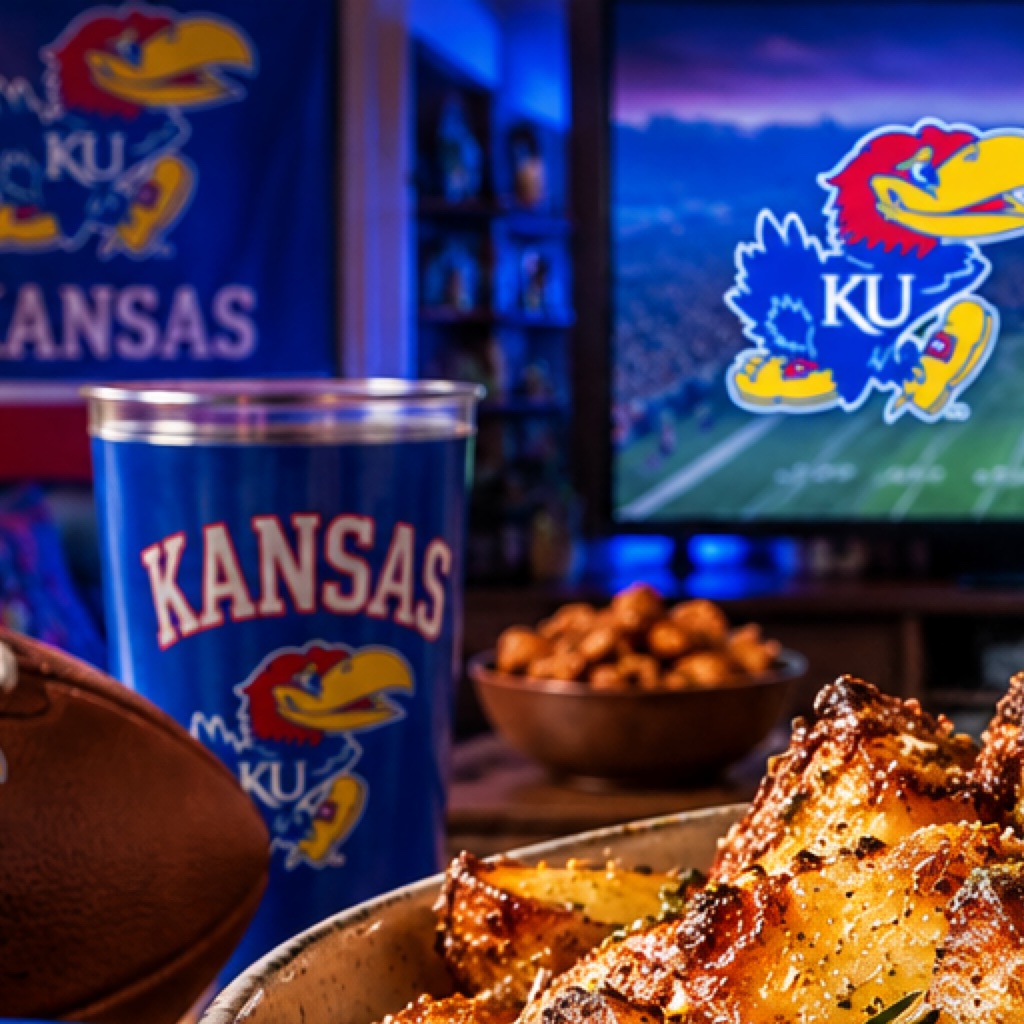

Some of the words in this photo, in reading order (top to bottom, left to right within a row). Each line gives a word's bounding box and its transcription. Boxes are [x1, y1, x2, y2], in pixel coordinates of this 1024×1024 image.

[46, 130, 125, 187] KU
[0, 283, 258, 360] ANSAS
[822, 273, 914, 334] KU
[141, 512, 453, 650] KANSAS
[237, 761, 306, 807] KU
